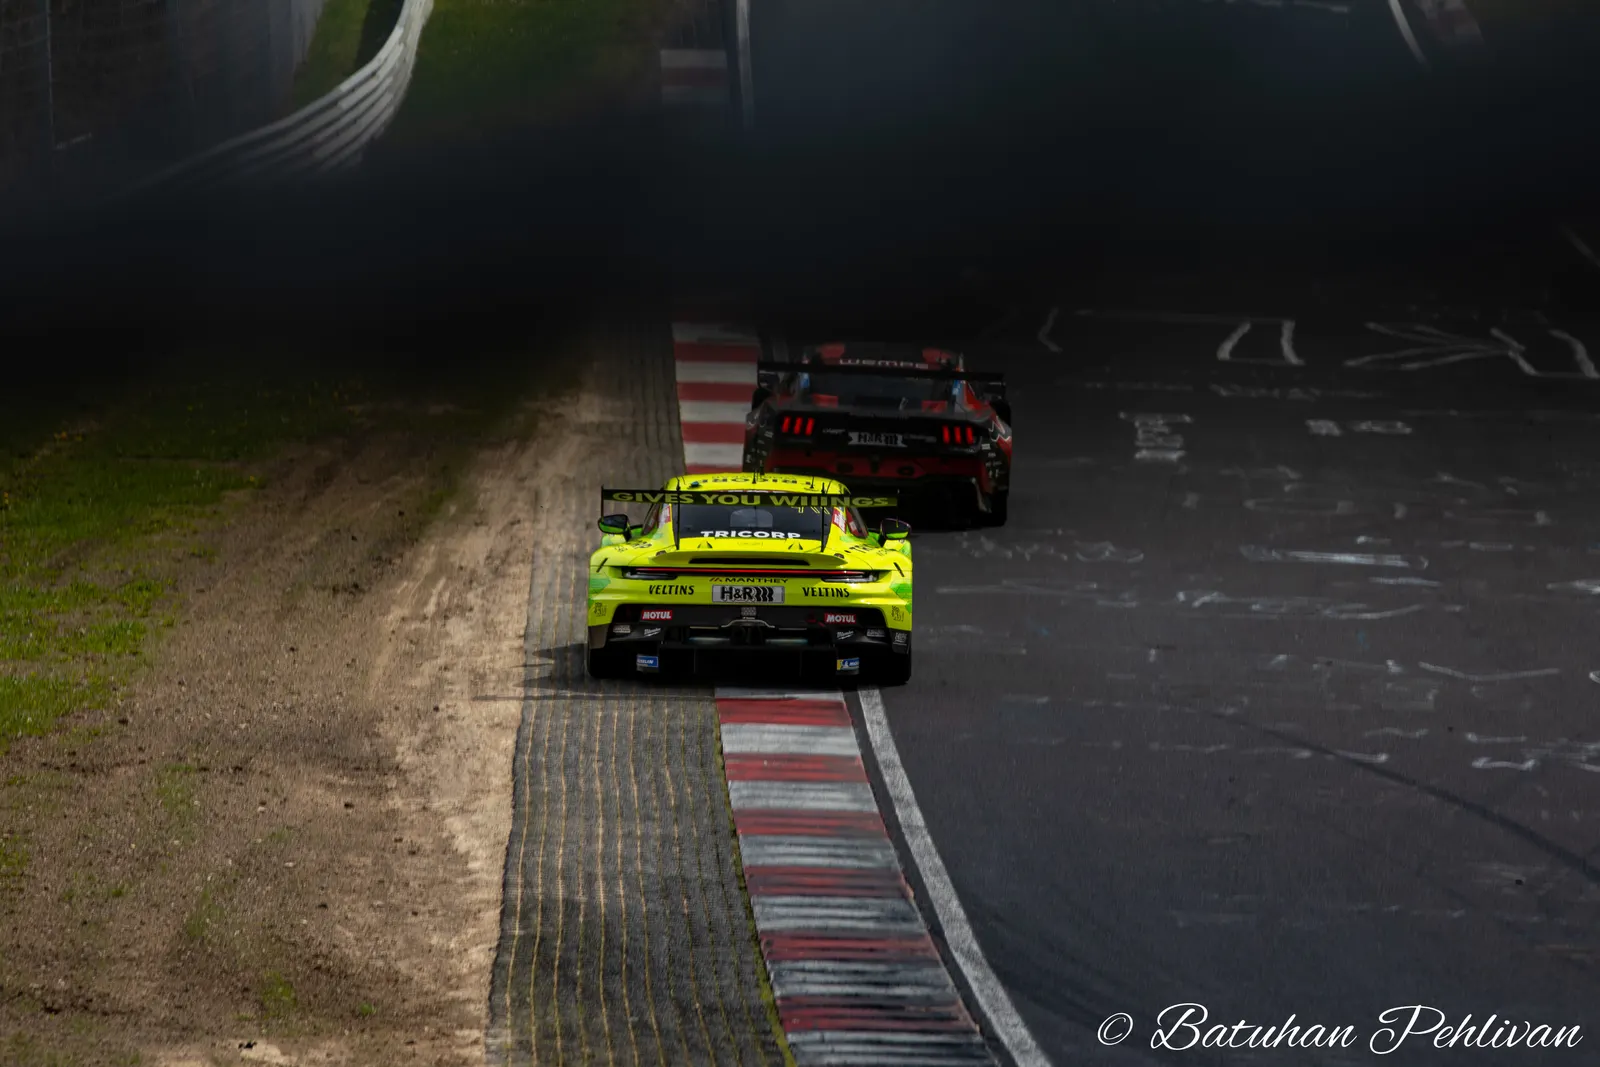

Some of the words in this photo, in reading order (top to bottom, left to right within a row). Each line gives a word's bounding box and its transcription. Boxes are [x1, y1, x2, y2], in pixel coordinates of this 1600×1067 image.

[612, 492, 694, 504] GIVES
[700, 494, 761, 506] YOU
[769, 495, 889, 507] WIIINGS
[700, 530, 801, 539] TRICORP
[648, 585, 695, 595] VELTINS
[720, 586, 753, 600] H&R
[802, 587, 850, 598] VELTINS
[642, 610, 672, 620] MOTUL
[826, 613, 856, 623] MOTUL
